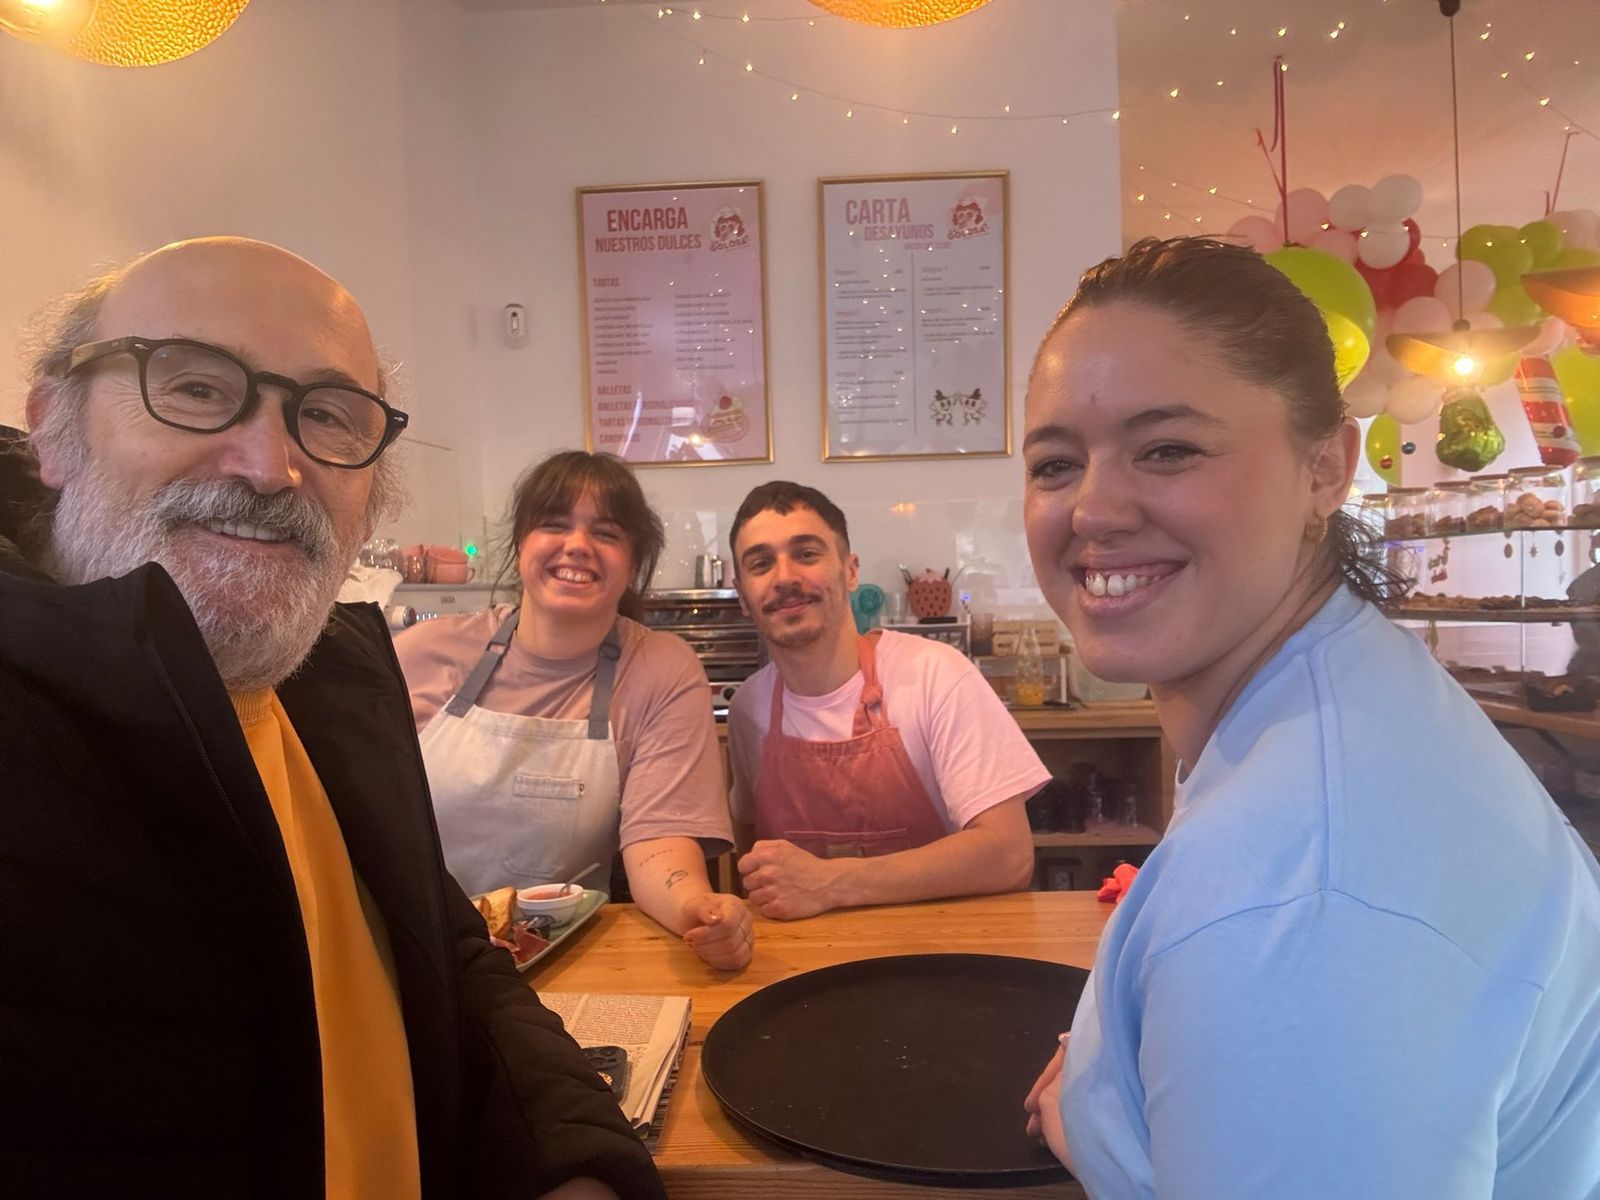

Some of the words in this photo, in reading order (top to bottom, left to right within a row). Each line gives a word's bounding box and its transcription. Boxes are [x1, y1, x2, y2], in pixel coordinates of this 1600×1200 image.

[606, 207, 689, 232] ENCARGA
[845, 198, 911, 225] CARTA
[595, 236, 655, 253] NUESTROS
[657, 234, 702, 250] DULCES
[864, 224, 934, 242] DESAYUNOS
